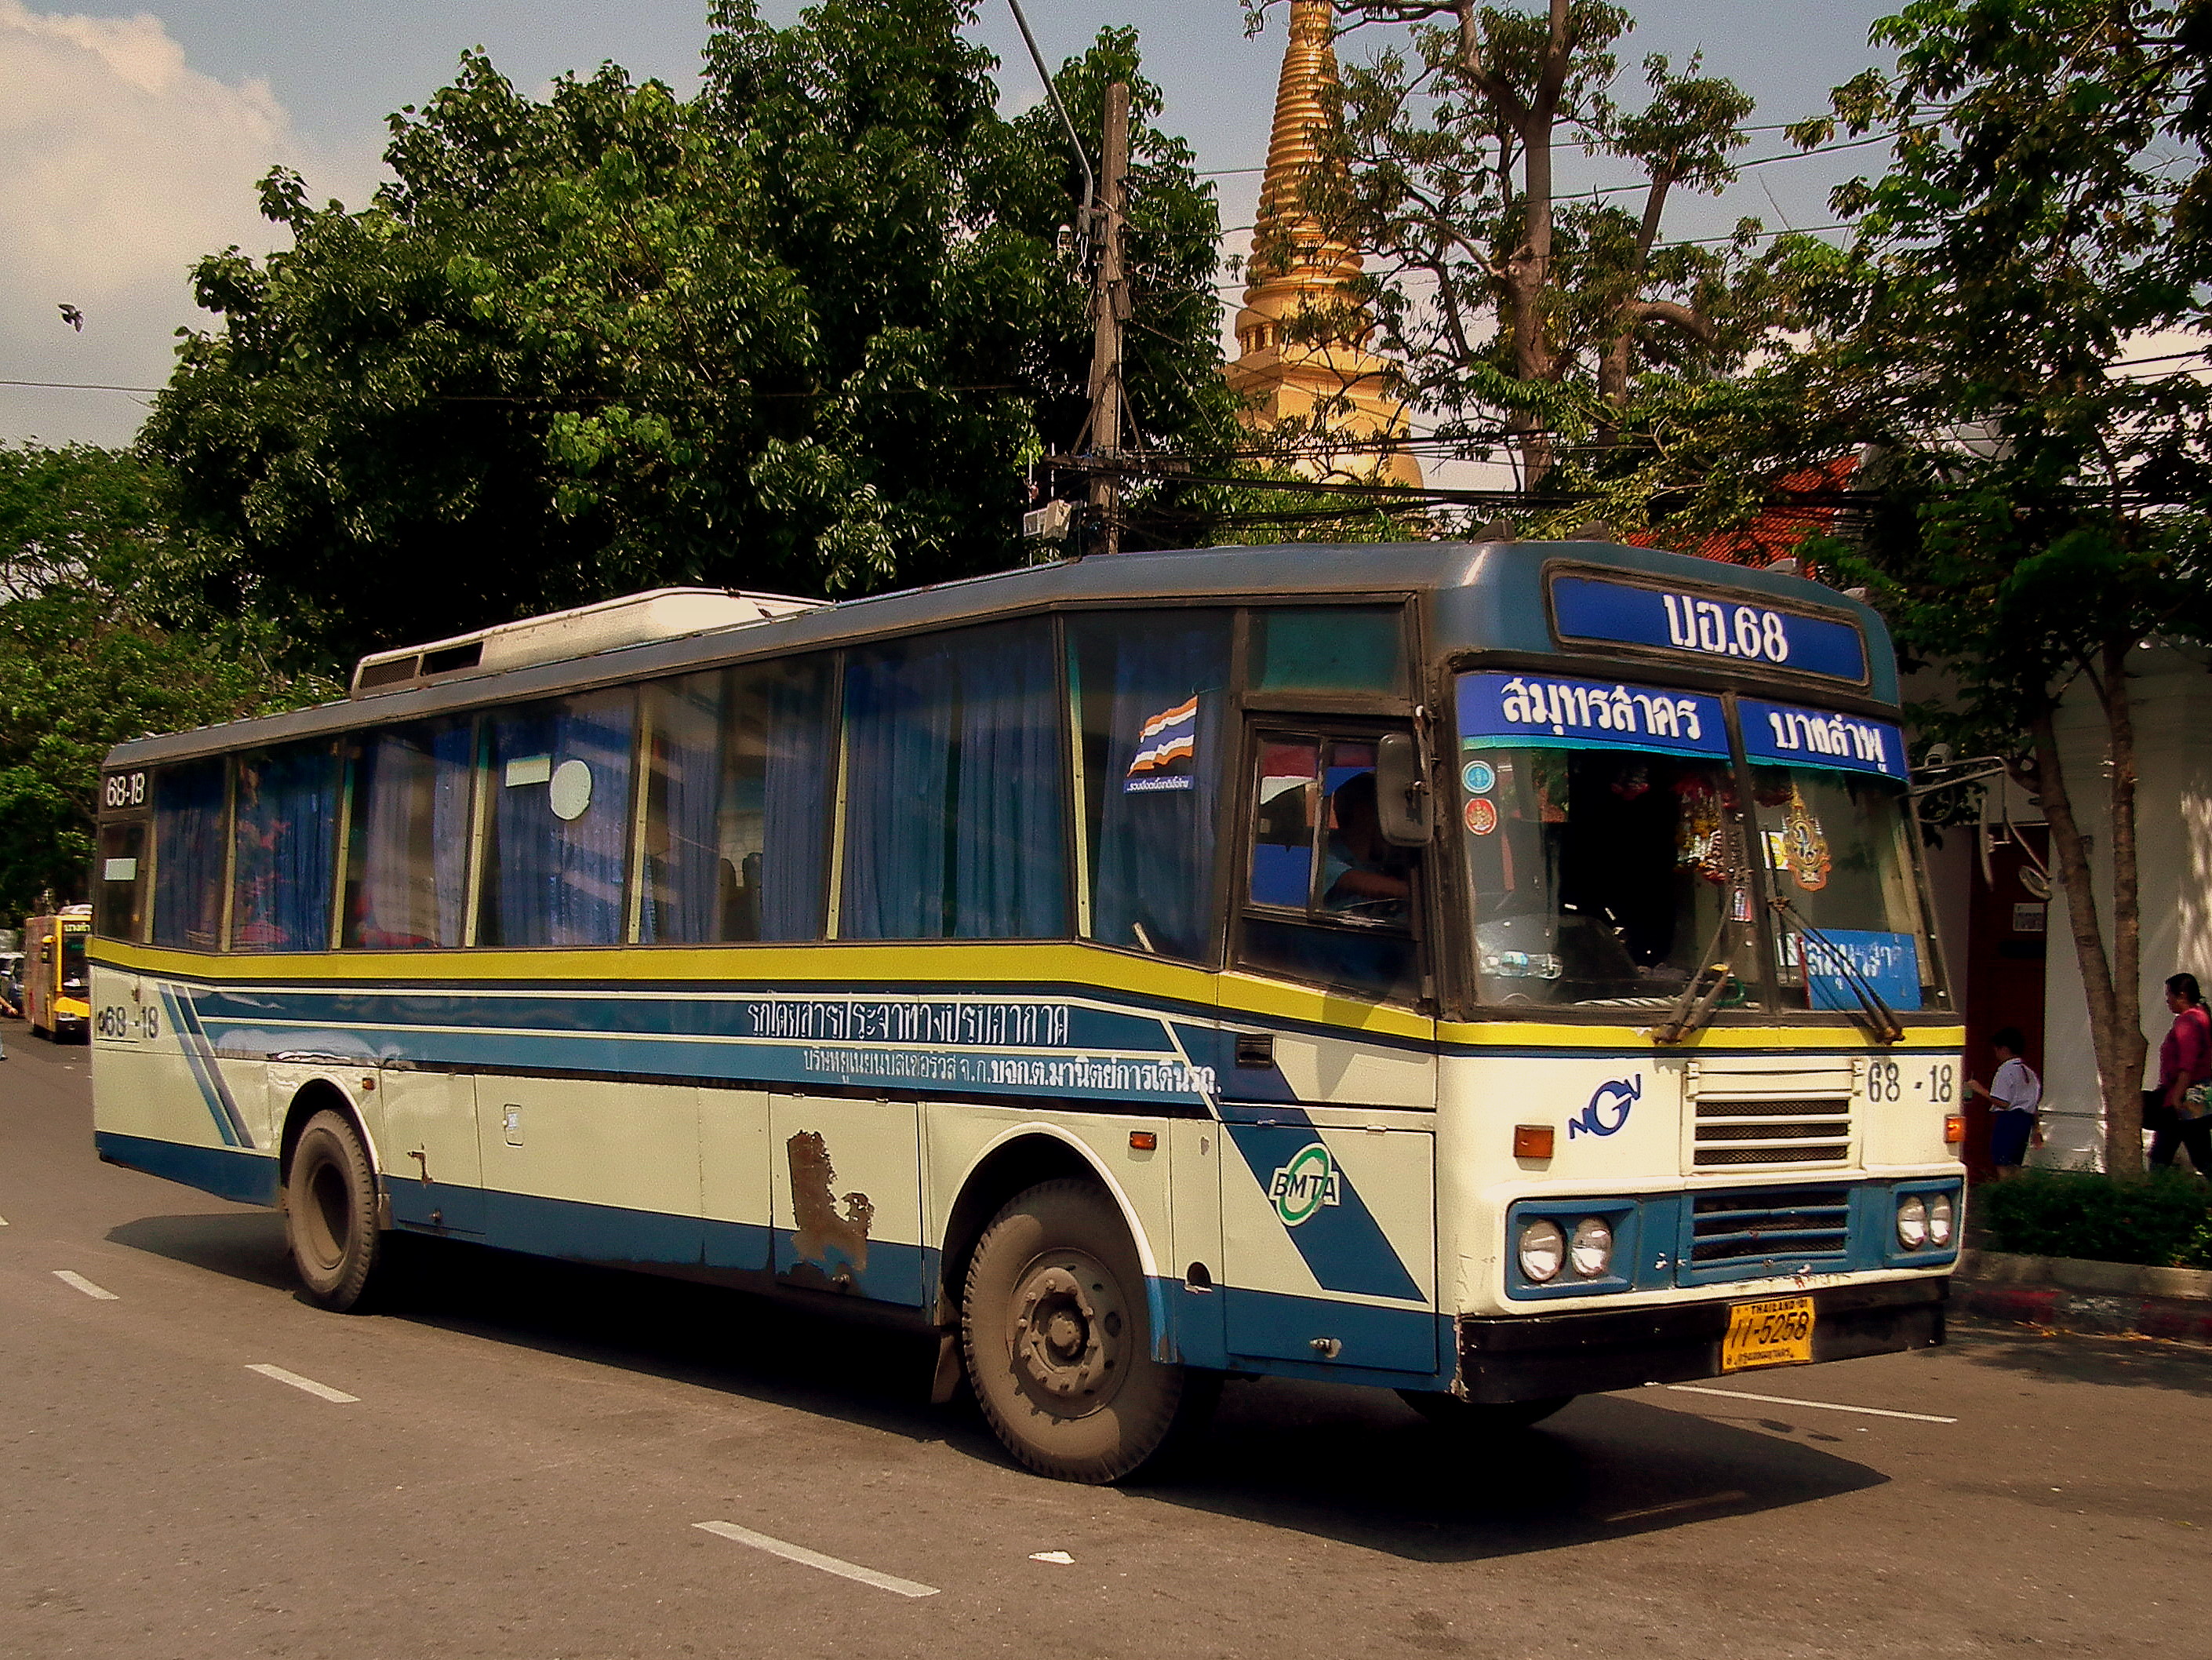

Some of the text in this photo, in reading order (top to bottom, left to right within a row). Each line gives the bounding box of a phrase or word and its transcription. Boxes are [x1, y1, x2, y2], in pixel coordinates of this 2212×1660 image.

[1663, 594, 1789, 663] ปอ.68
[1501, 677, 1701, 741] สมุทรสาคร
[1769, 712, 1887, 774] บางลำพู
[1569, 1073, 1642, 1140] NGV
[1274, 1172, 1337, 1202] BMTA
[1730, 1311, 1810, 1349] 11-5258
